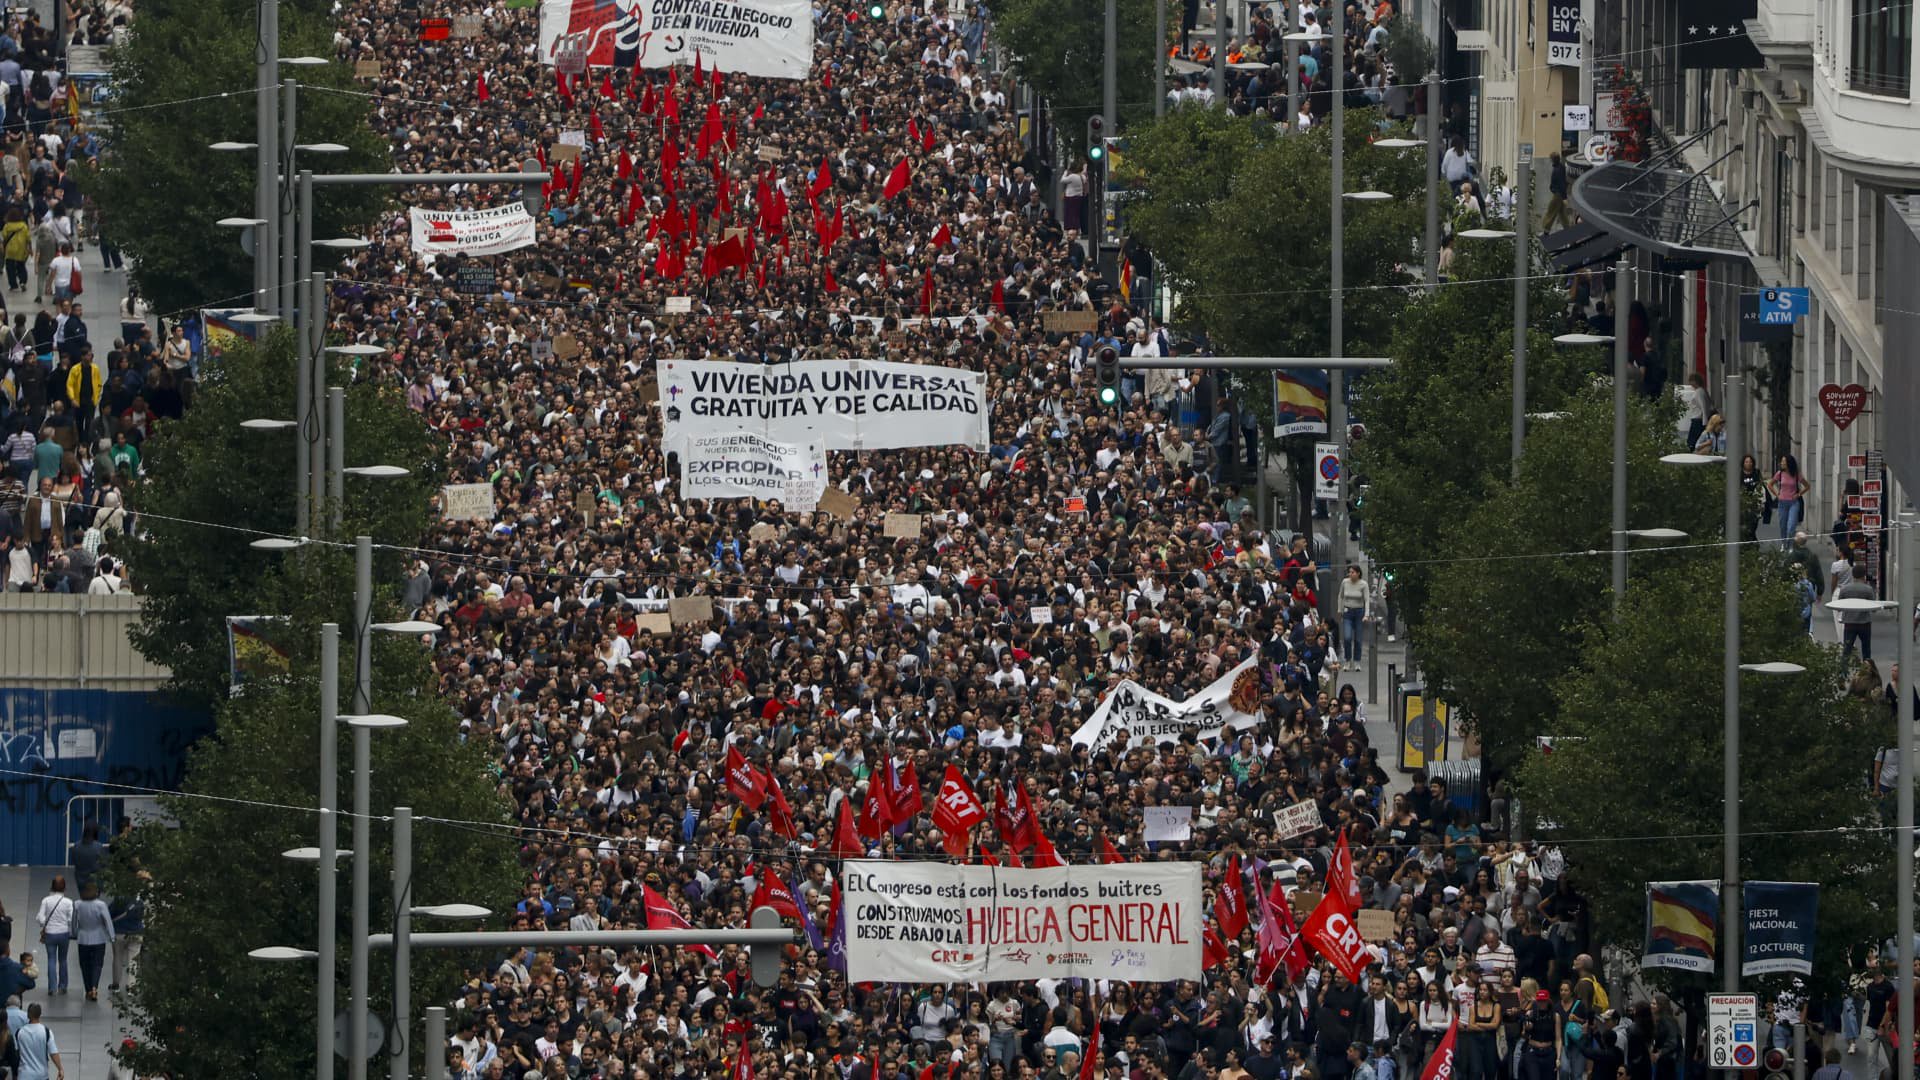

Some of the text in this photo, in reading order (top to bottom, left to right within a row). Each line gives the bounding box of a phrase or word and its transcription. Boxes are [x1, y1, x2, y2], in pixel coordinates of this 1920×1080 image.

[652, 0, 792, 29] CONTRA EL NEGOCIO
[1553, 6, 1580, 19] LOC
[652, 15, 760, 38] DE LA VIVIENDA
[1553, 20, 1570, 32] EN
[1552, 46, 1571, 58] 917
[423, 204, 522, 222] UNIVERSITARIO
[458, 231, 502, 245] PÚBLICA
[1765, 311, 1792, 323] ATM
[691, 370, 815, 396] VIVIENDA
[821, 370, 976, 396] UNIVERSAL
[690, 393, 979, 419] GRATUITA Y DE CALIDAD
[695, 435, 797, 456] SUS BENEFICIOS
[705, 446, 747, 455] NUESTRA
[688, 460, 803, 480] EXPROPIAR
[694, 476, 721, 486] LOS
[725, 476, 785, 490] CULPABL
[1133, 726, 1145, 736] NI
[941, 780, 981, 817] CRT
[848, 874, 864, 892] El
[866, 874, 932, 898] Congreso
[936, 882, 966, 898] está
[970, 884, 996, 898] con
[1032, 882, 1088, 899] fondos
[1098, 880, 1162, 898] buitres
[857, 904, 962, 924] CONSTRUYAMOS
[1749, 909, 1778, 918] FIESTA
[966, 903, 1189, 945] HUELGA GENERAL
[1750, 920, 1798, 931] NACIONAL
[857, 925, 962, 944] DESDE ABAJO LA
[1326, 913, 1368, 964] CRT
[931, 950, 959, 962] CRT
[1750, 943, 1805, 955] 12 OCTUBRE
[1667, 957, 1698, 967] MADRID
[1716, 1051, 1725, 1061] 30
